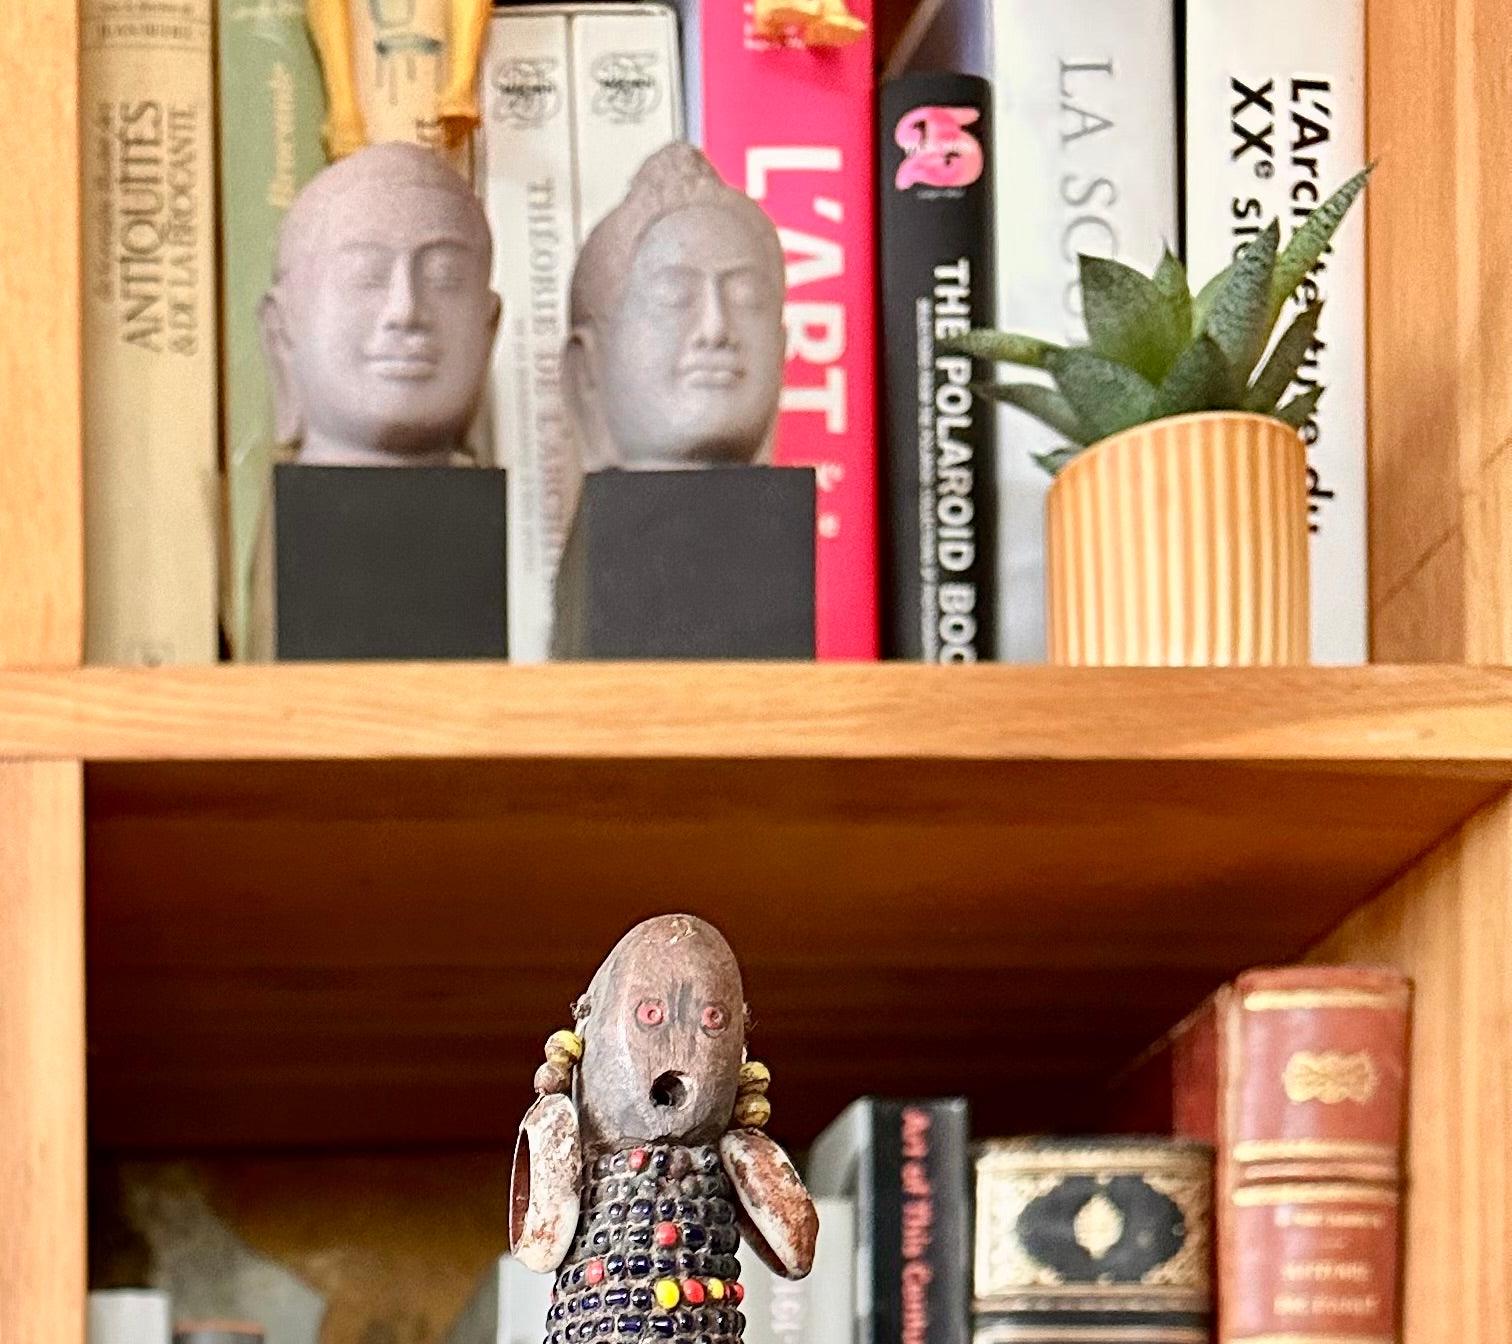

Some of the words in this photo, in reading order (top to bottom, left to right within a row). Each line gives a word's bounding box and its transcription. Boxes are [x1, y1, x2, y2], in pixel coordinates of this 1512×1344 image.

[1057, 56, 1116, 145] LA
[114, 100, 165, 355] ANTIQUITÉS
[933, 257, 972, 340] THE
[934, 355, 976, 574] POLAROID
